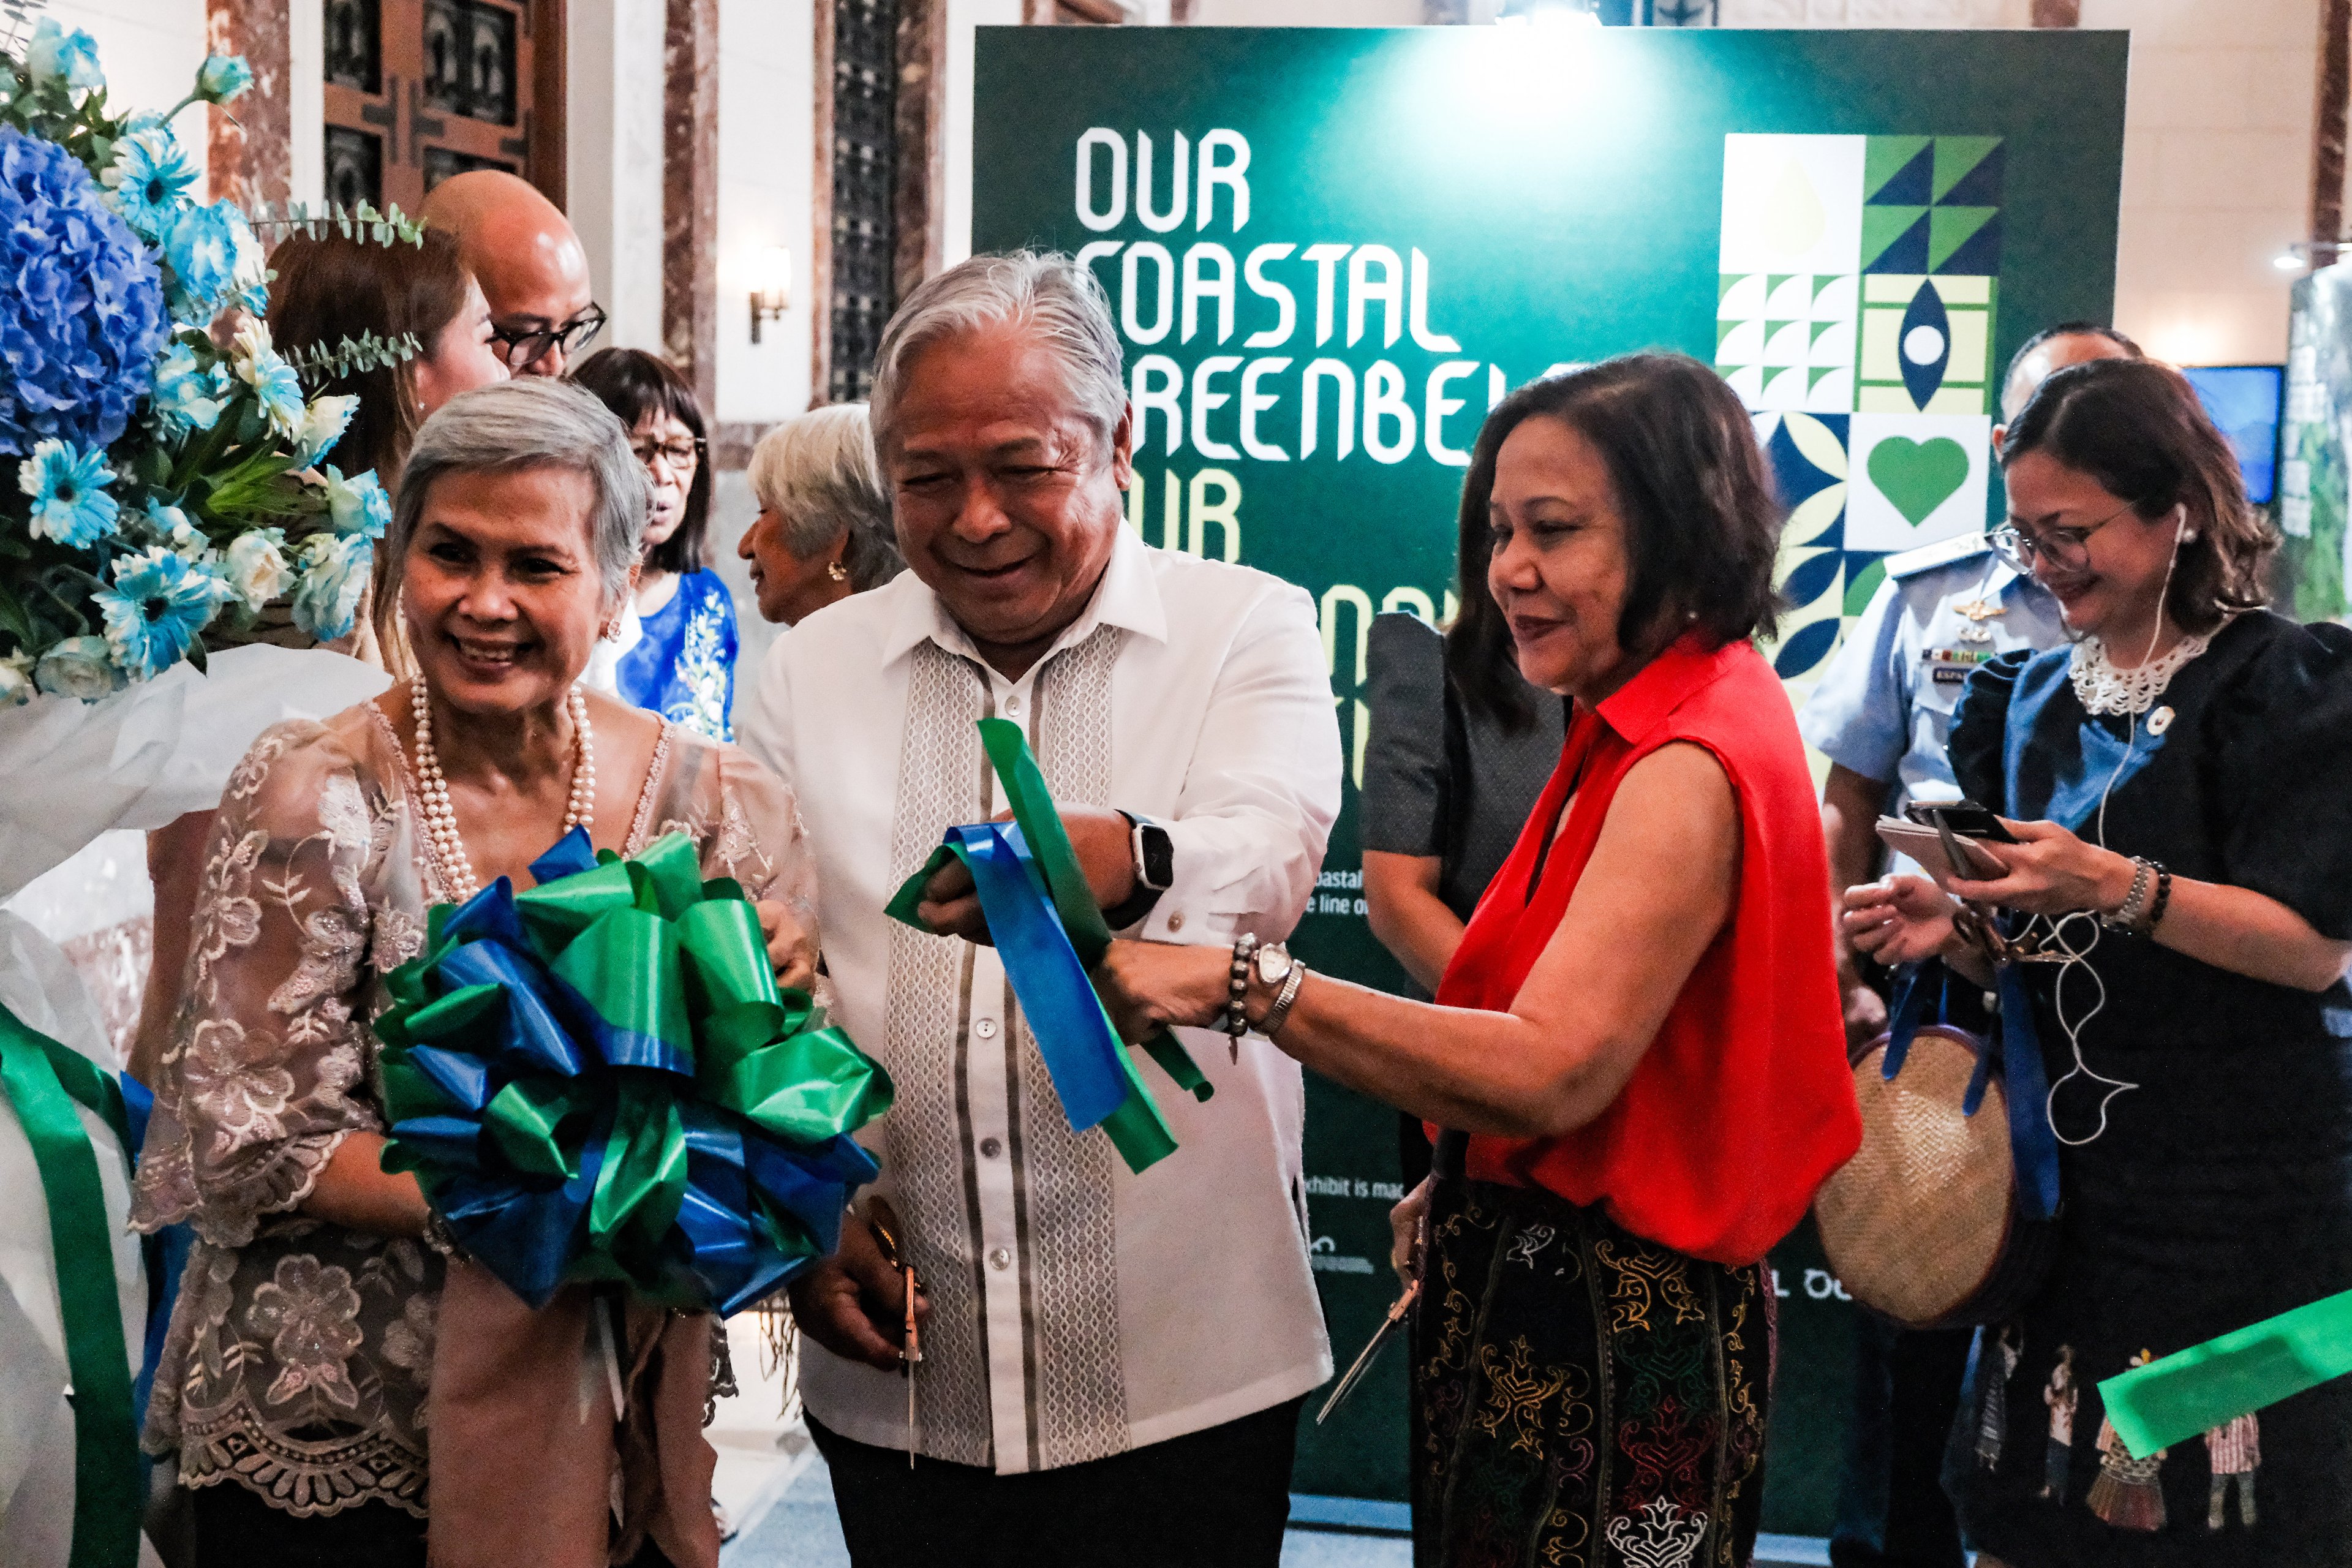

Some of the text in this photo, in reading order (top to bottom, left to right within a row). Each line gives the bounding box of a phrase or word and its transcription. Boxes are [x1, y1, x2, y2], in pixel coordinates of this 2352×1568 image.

[1075, 127, 1251, 233] OUR
[1128, 468, 1242, 564] UR
[1319, 894, 1350, 914] line
